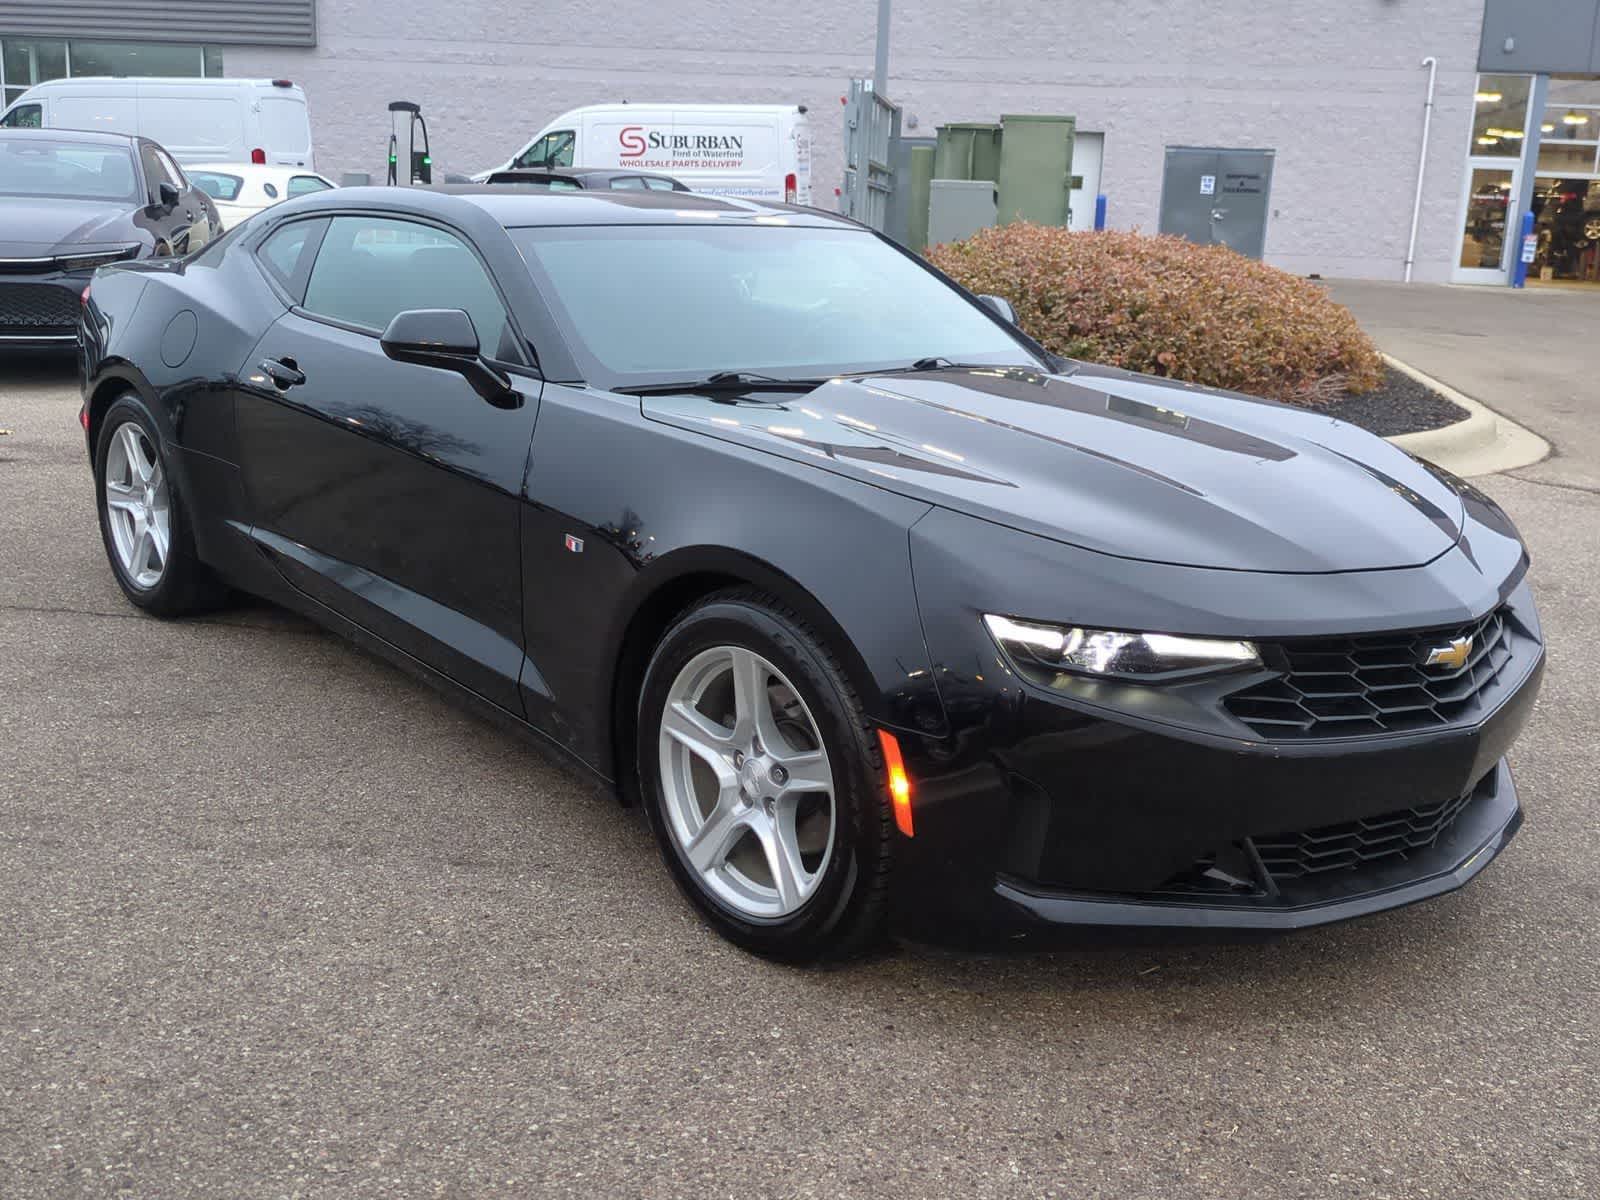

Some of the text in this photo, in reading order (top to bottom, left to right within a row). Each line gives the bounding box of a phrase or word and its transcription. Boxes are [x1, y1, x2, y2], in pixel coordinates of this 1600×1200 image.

[648, 131, 743, 149] SUBURBAN
[672, 150, 743, 158] Ford of Waterford
[619, 160, 743, 168] WHOLESALE PARTS DELIVERY
